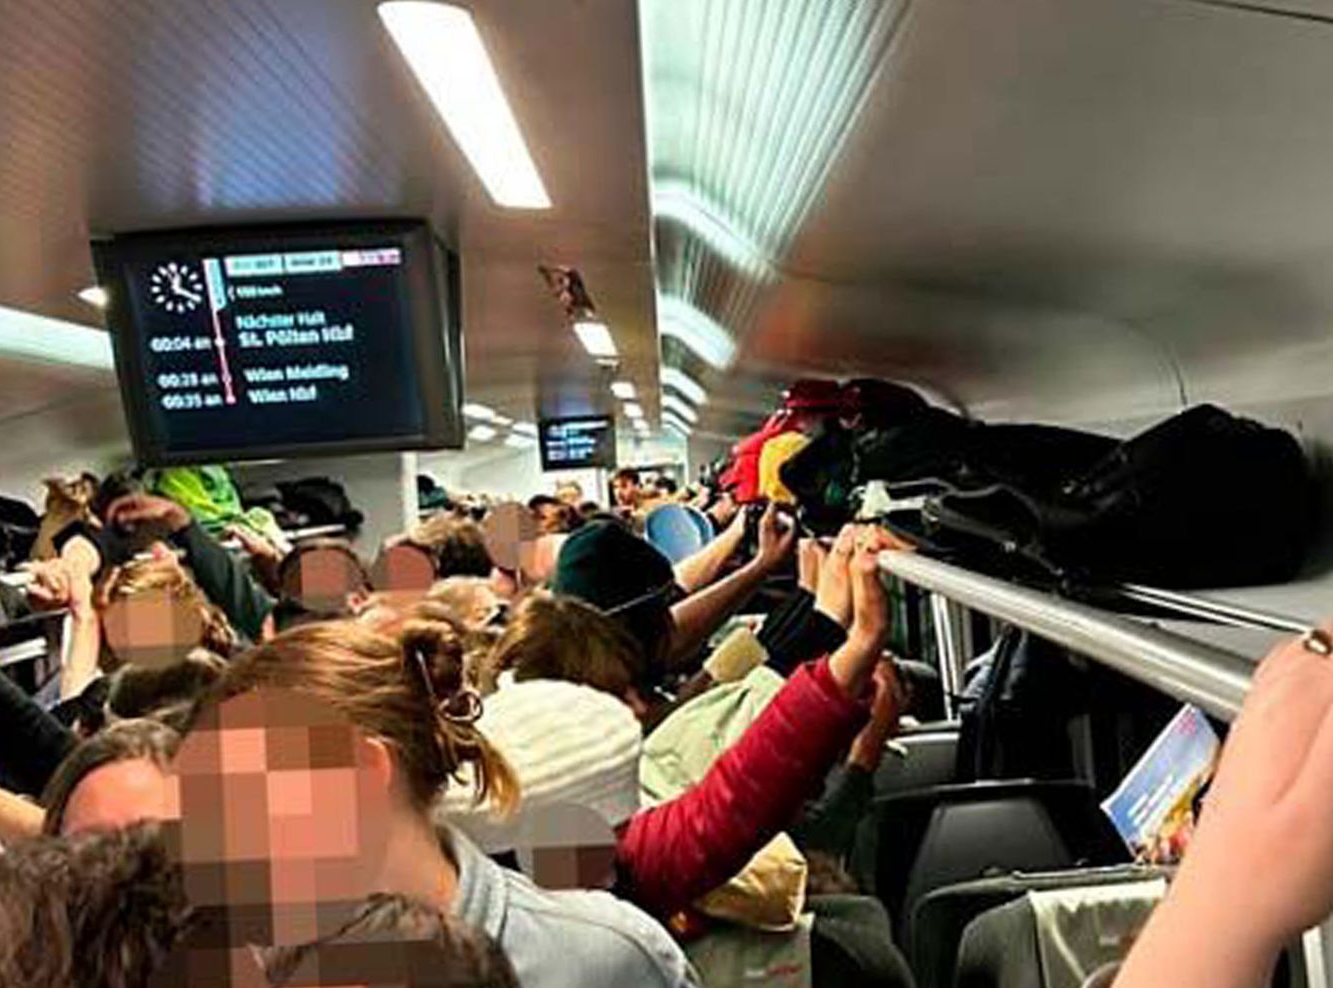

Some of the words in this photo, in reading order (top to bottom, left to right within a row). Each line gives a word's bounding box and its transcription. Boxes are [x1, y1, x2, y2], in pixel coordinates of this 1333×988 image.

[151, 336, 191, 352] 00:04
[238, 331, 264, 347] St.
[265, 328, 320, 346] Pölten
[321, 323, 354, 342] Hbf
[243, 367, 284, 382] Wien
[286, 363, 349, 381] Meidling
[247, 388, 288, 403] Wien
